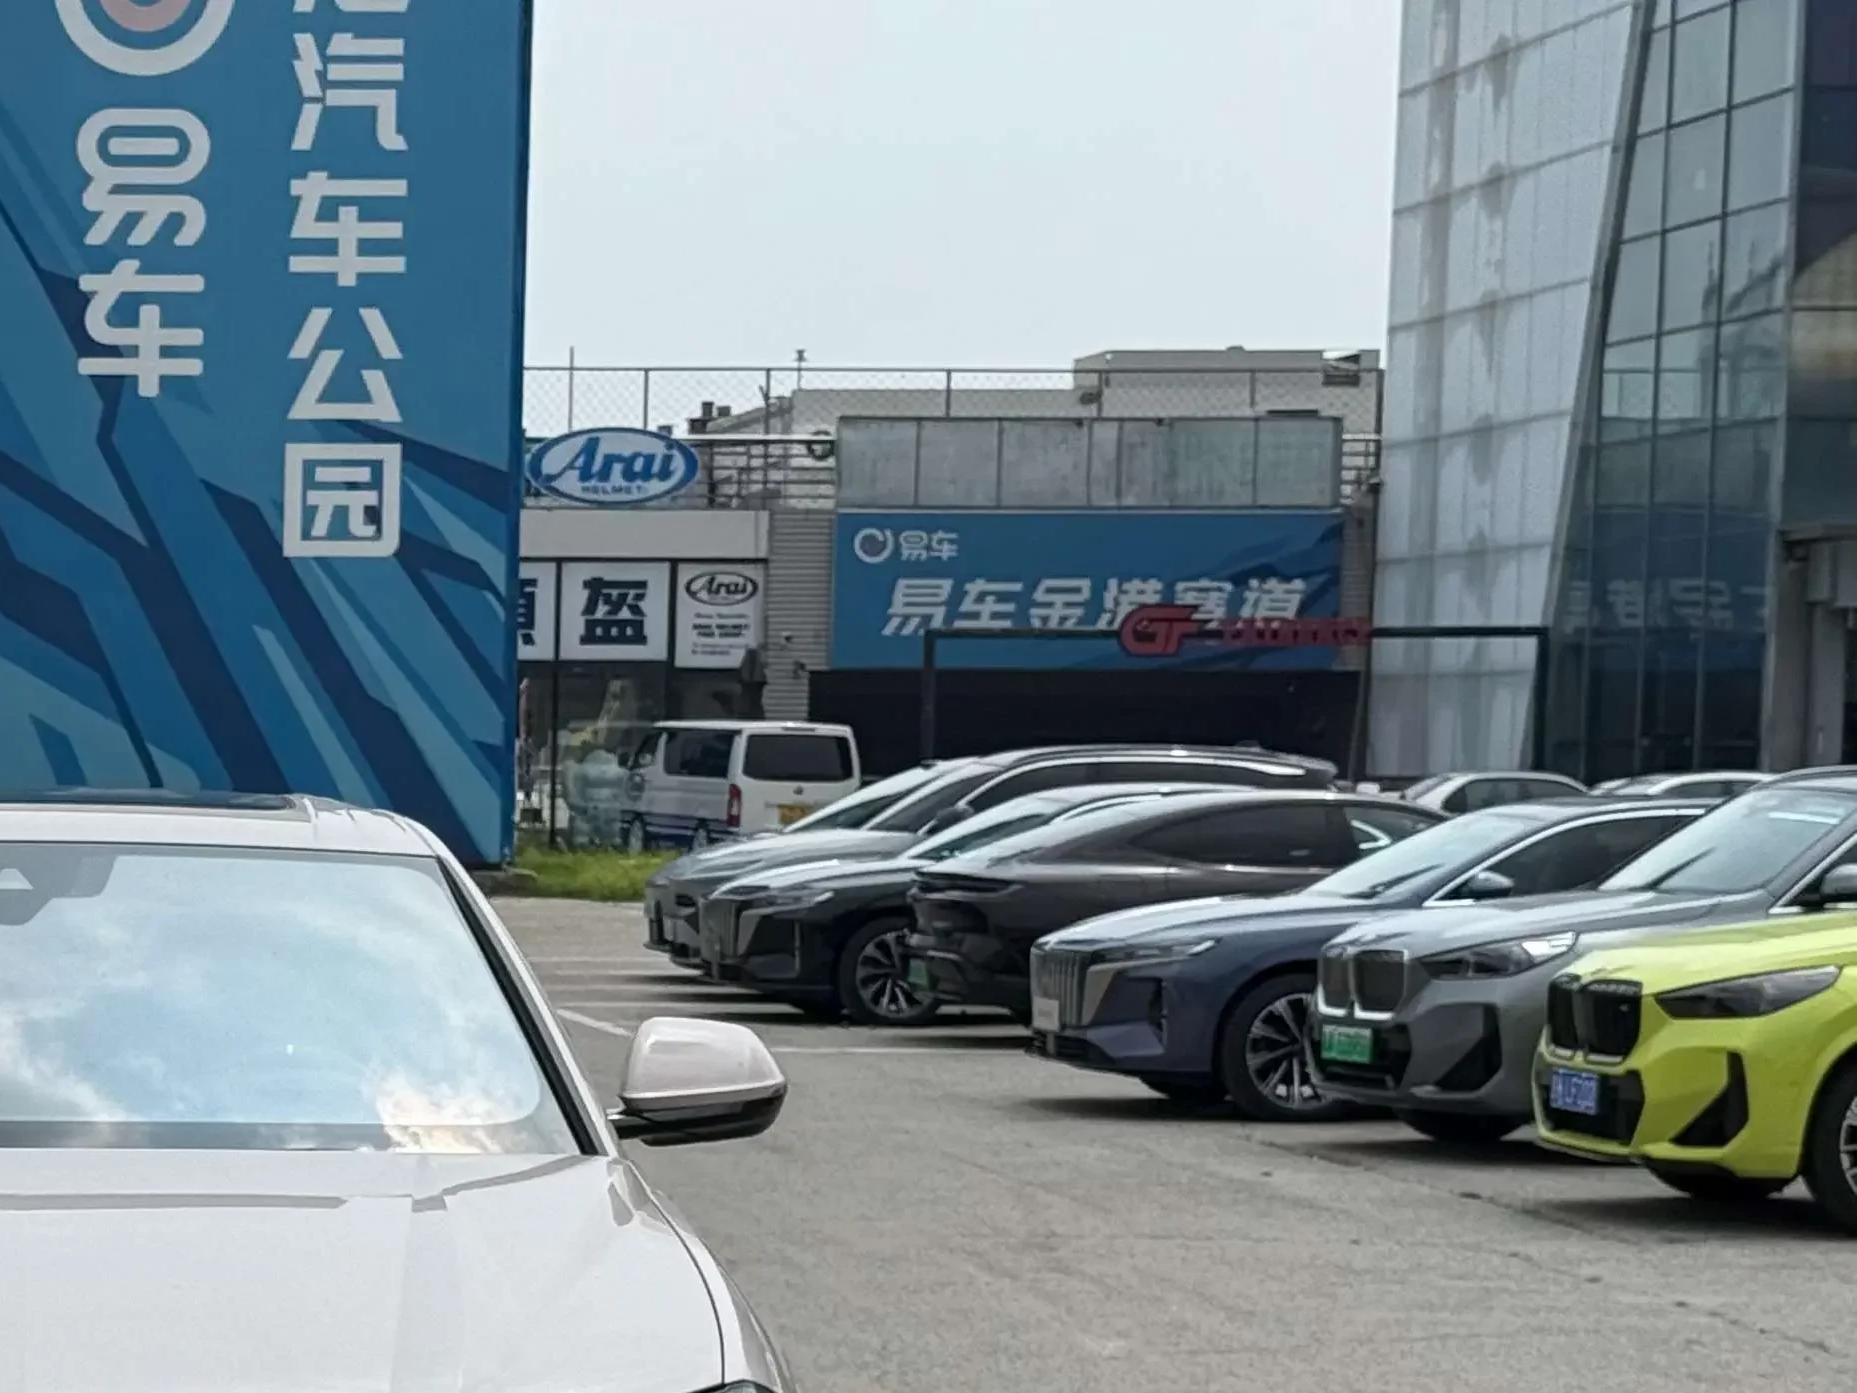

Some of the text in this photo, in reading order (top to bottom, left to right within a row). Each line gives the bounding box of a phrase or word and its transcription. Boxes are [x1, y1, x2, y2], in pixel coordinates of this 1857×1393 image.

[76, 108, 211, 398] 易车
[283, 0, 409, 557] 汽车公园
[539, 436, 676, 484] Arai
[899, 529, 959, 562] 易车
[690, 576, 748, 596] Arai
